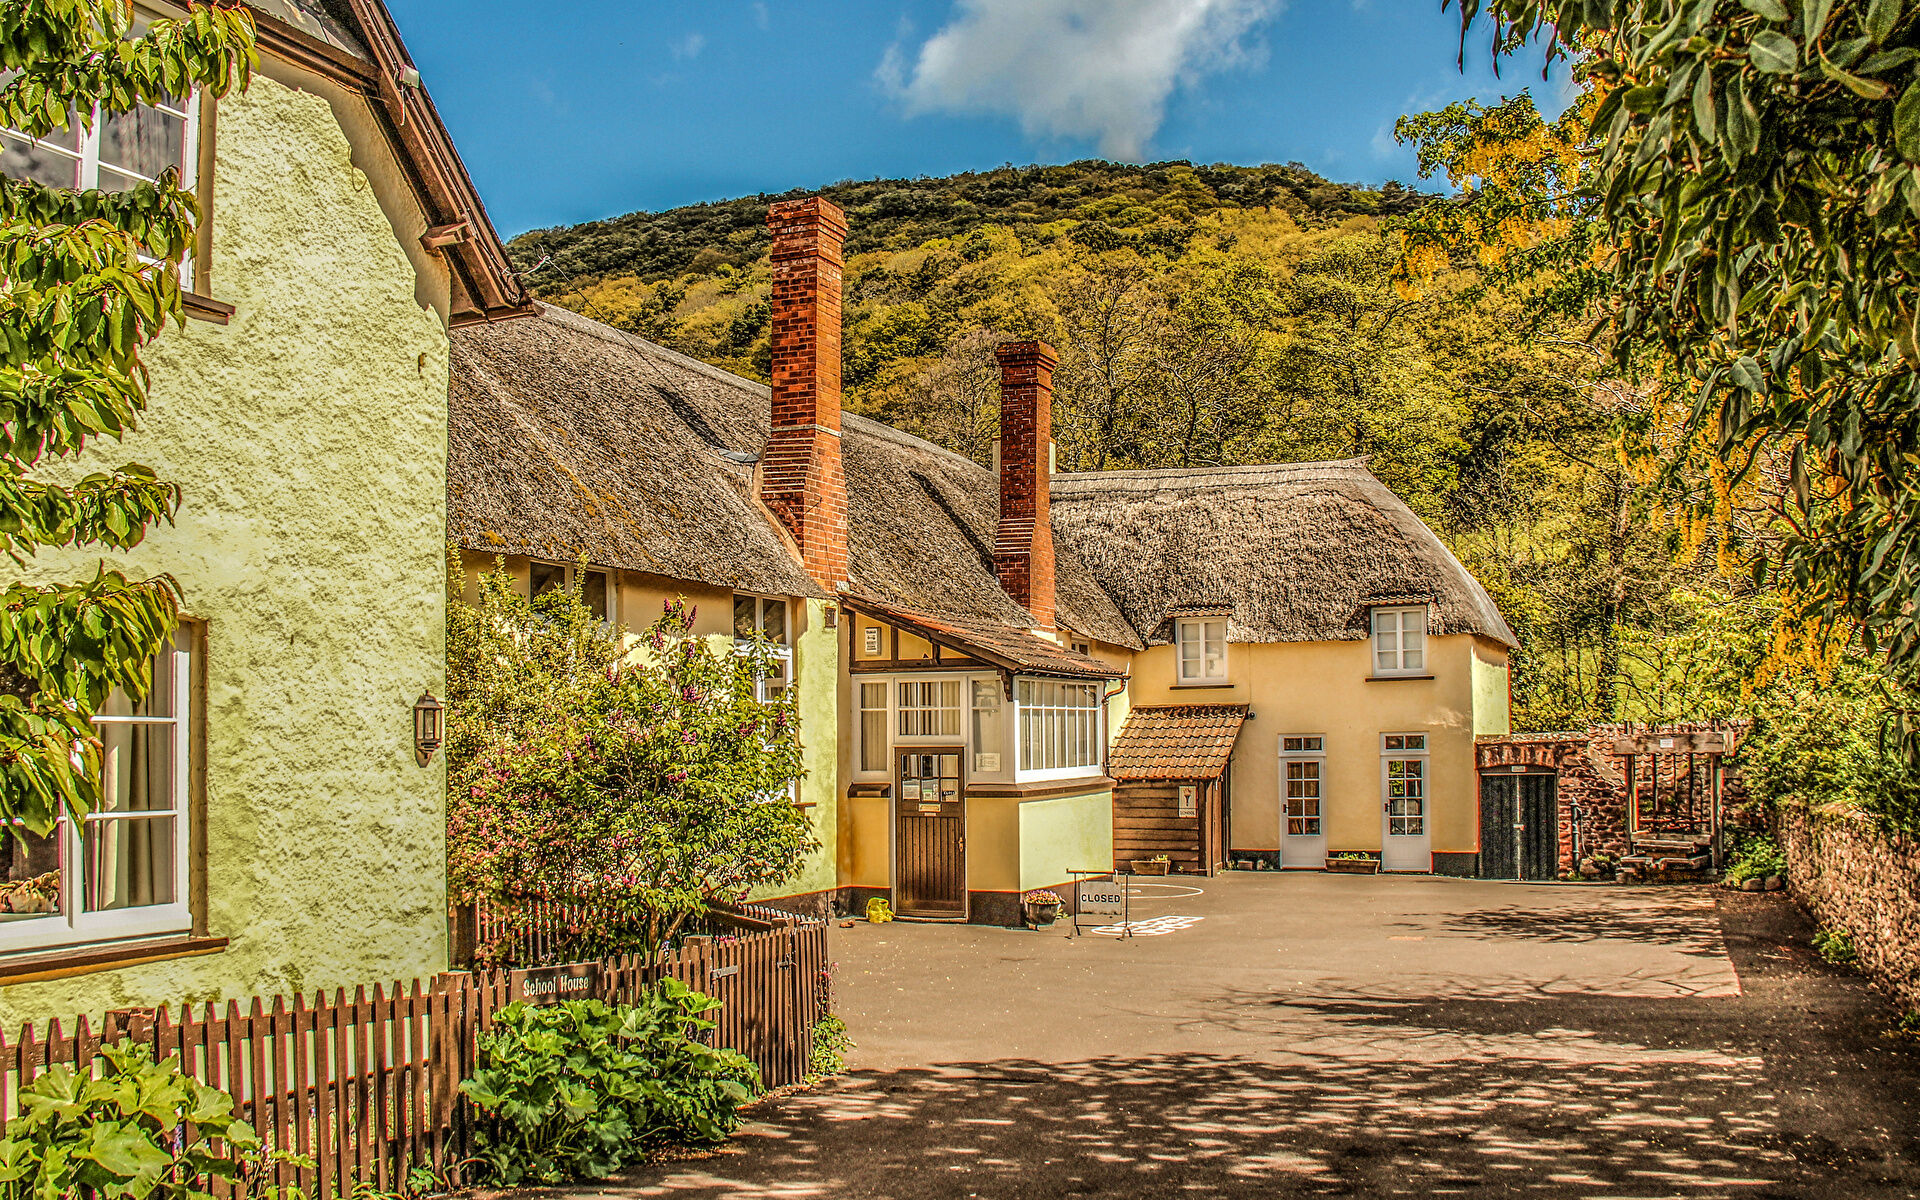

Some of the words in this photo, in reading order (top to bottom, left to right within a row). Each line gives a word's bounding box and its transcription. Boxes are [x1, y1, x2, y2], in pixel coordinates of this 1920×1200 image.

[1081, 893, 1121, 903] CLOSED
[523, 976, 557, 998] School
[560, 974, 589, 993] House
